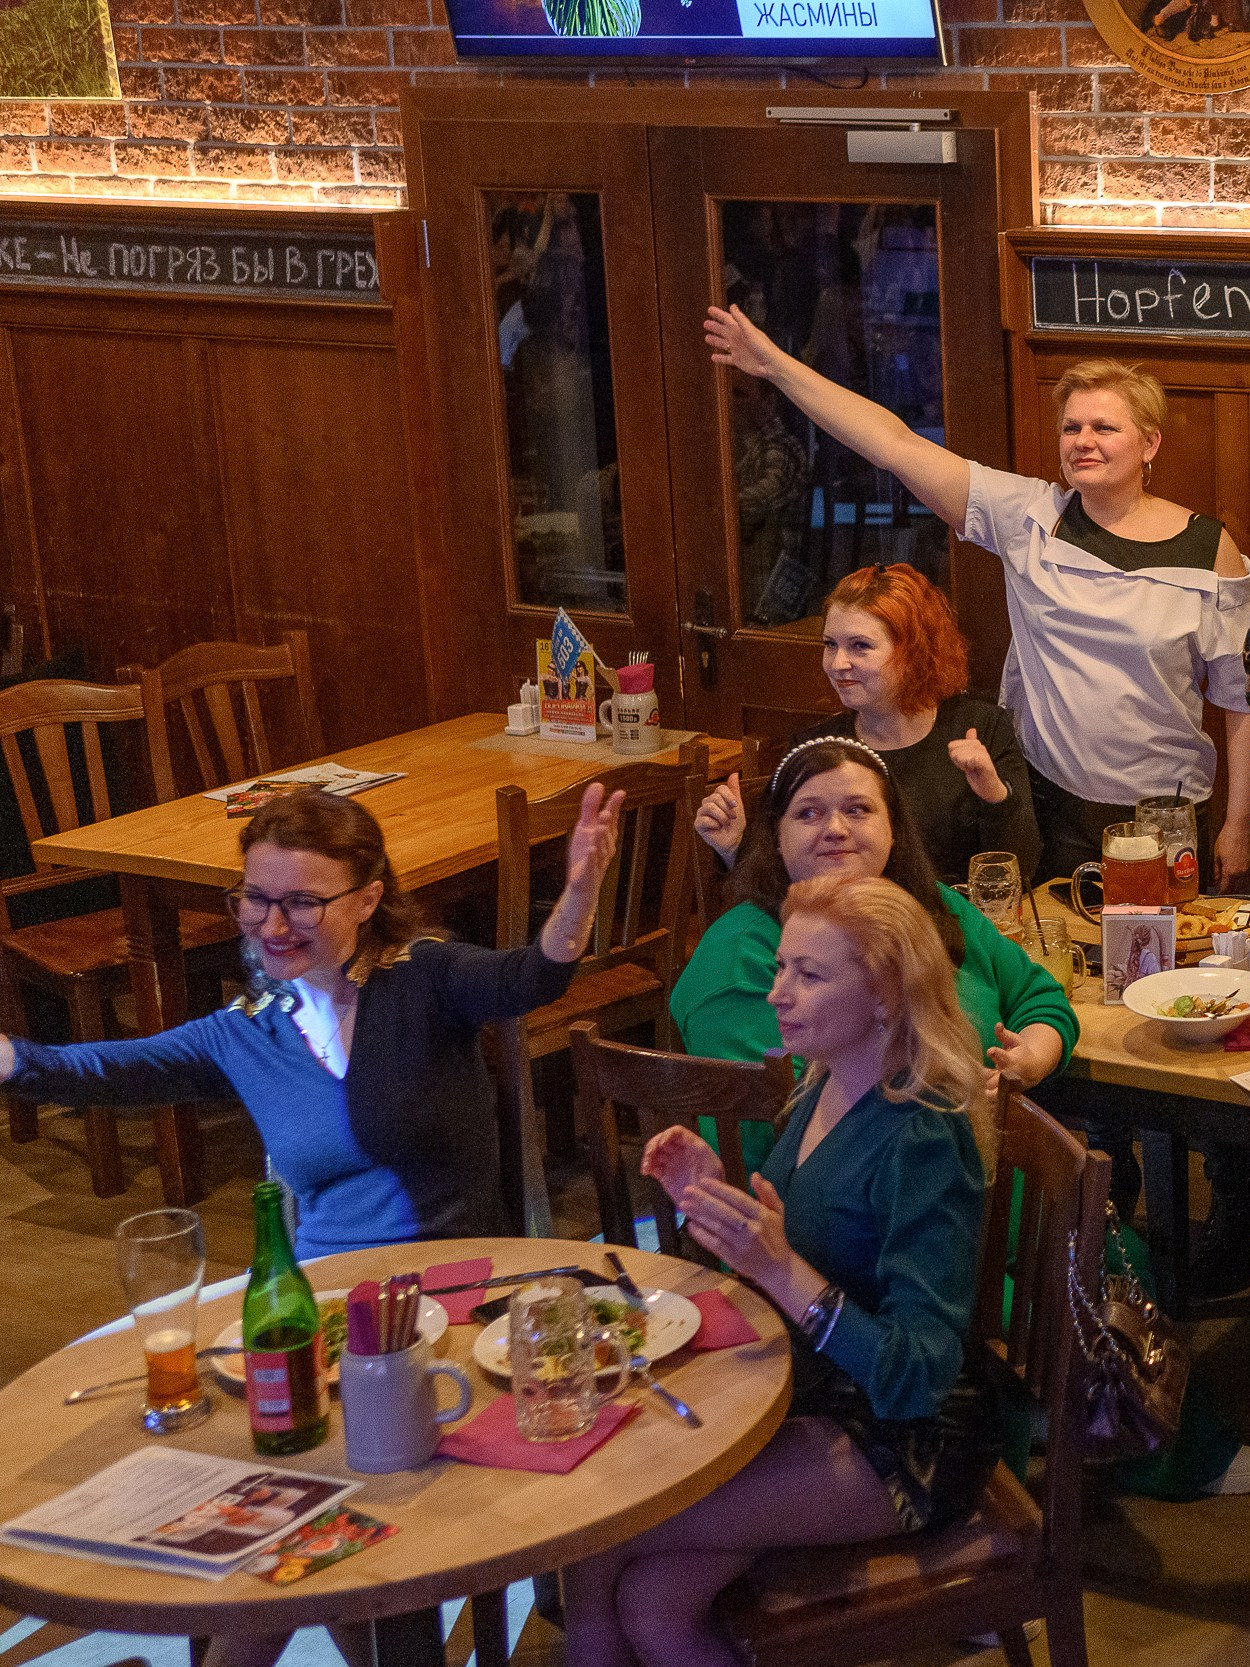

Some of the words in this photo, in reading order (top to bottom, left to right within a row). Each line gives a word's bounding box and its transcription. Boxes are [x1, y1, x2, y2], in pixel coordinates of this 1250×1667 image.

[754, 2, 878, 27] ЖАСМИНЫ
[108, 243, 221, 282] ПОГРЯЗ
[232, 247, 274, 284] БЫ
[286, 246, 306, 284] В
[557, 636, 574, 670] 503
